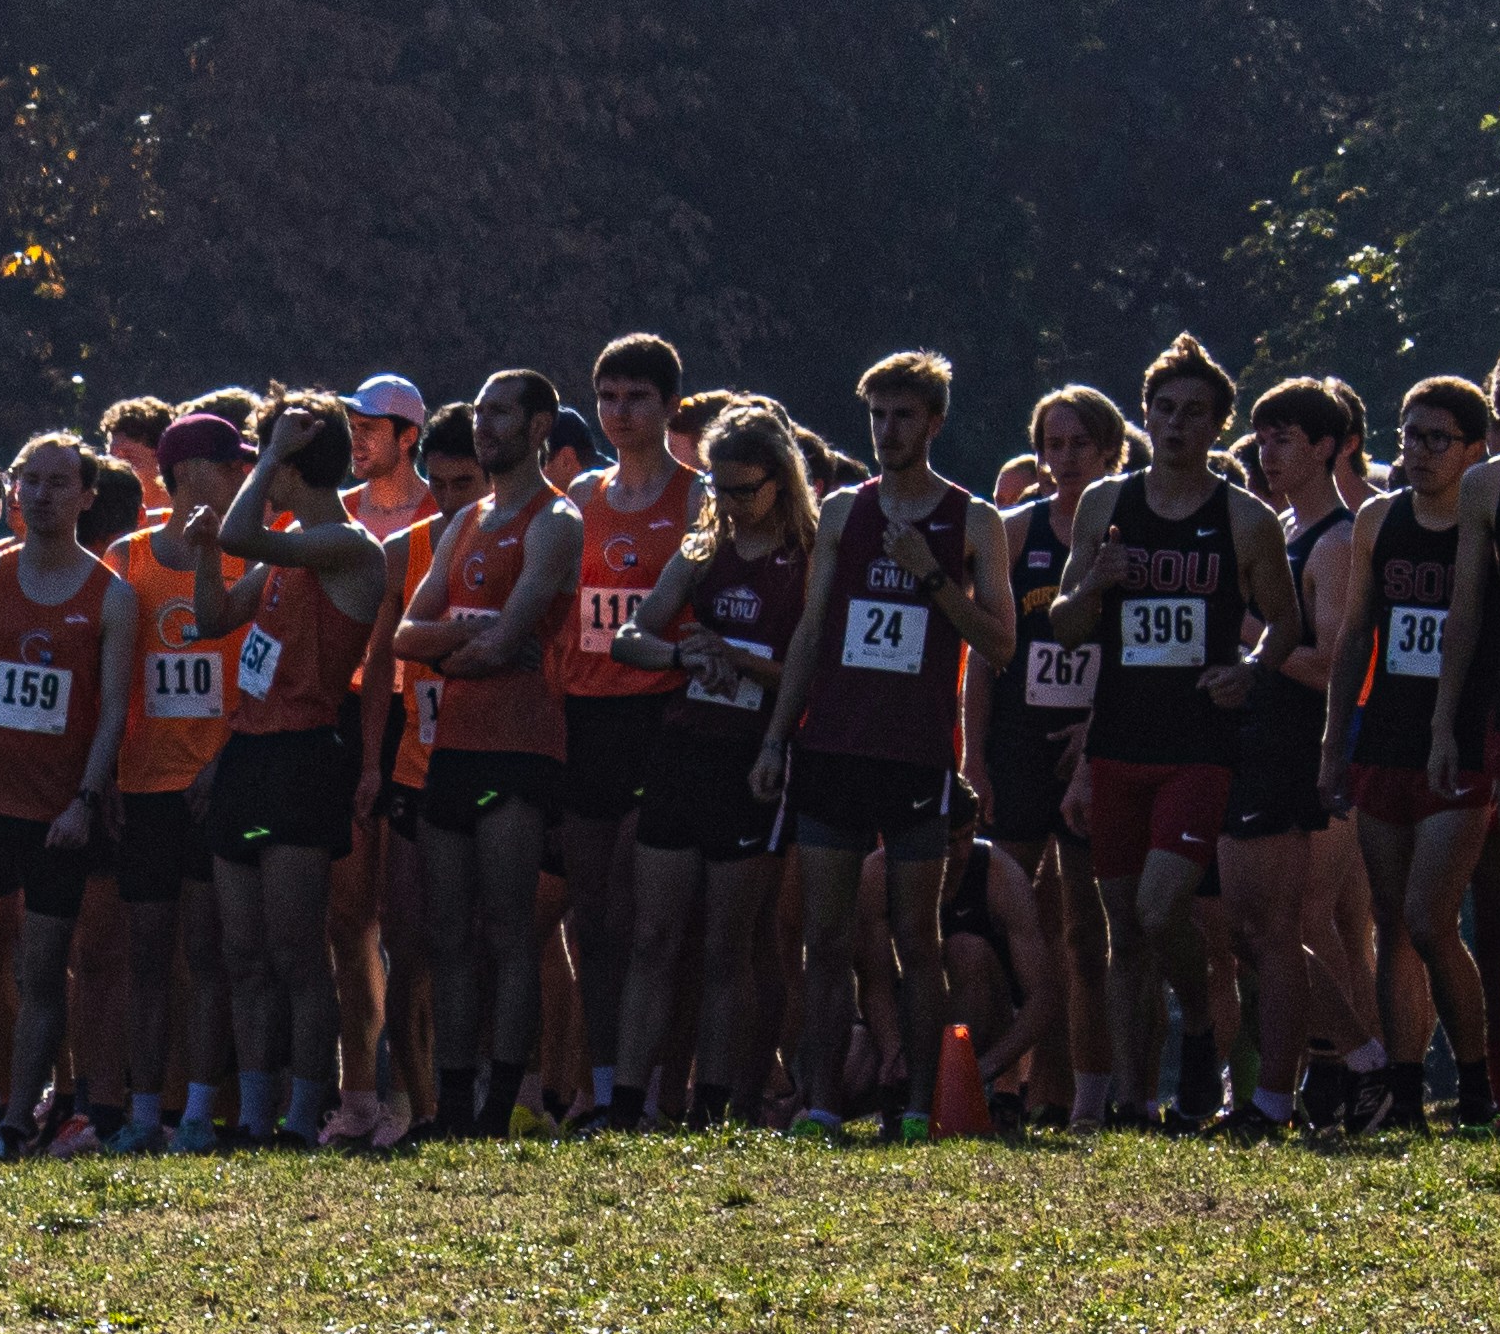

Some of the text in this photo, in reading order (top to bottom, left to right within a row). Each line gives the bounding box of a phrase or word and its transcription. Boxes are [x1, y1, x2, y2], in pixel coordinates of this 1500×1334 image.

[869, 566, 915, 590] CWU
[1121, 547, 1220, 595] SOU
[715, 597, 759, 620] CWU
[1133, 605, 1193, 644] 396
[864, 608, 902, 648] 24
[155, 658, 211, 695] 110
[1036, 648, 1091, 685] 267
[2, 668, 60, 711] 159
